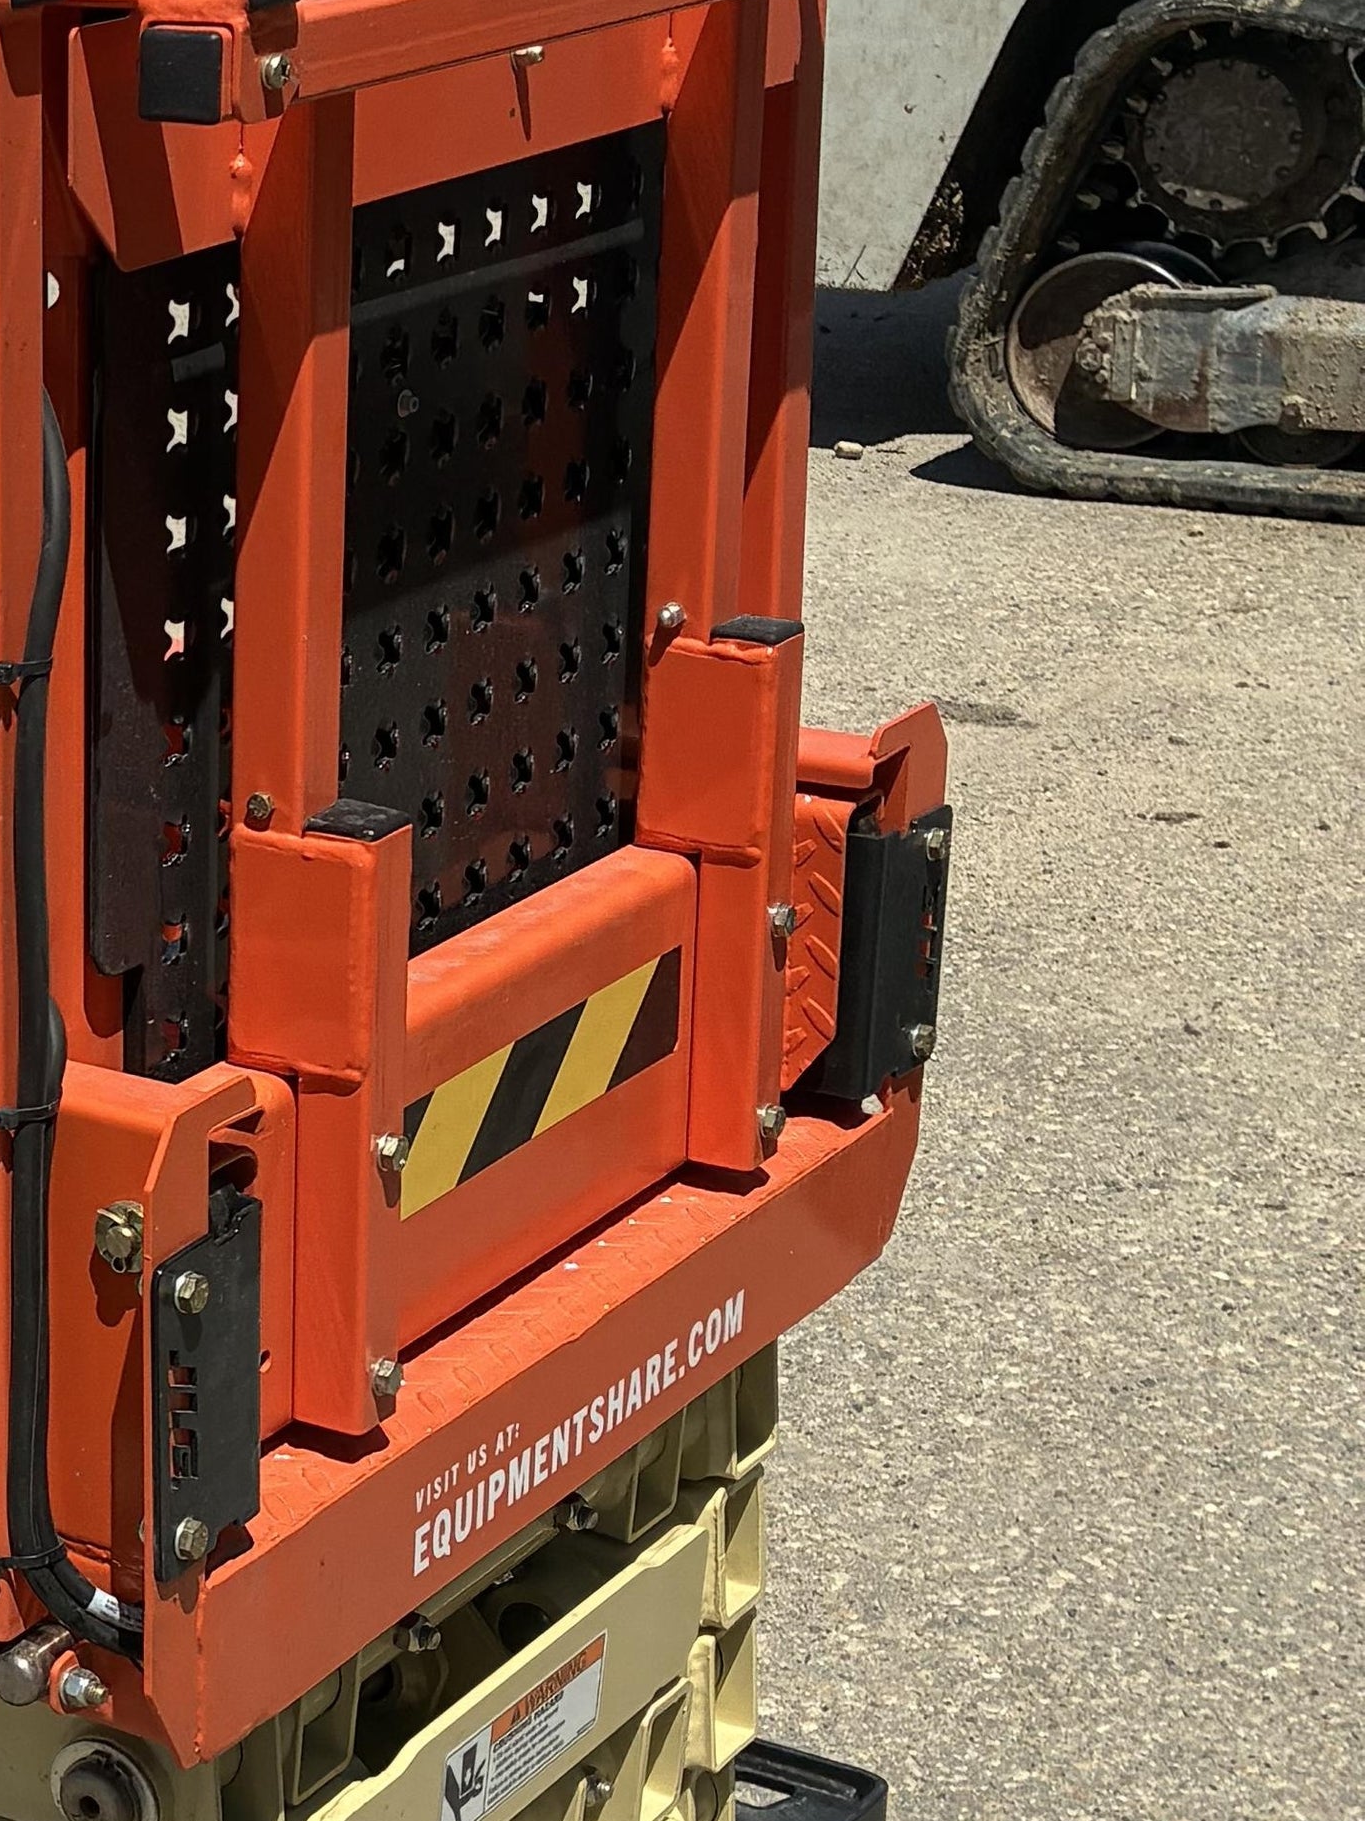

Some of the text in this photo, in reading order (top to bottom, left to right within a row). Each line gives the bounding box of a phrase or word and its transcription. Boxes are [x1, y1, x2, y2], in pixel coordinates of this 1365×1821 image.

[413, 1289, 746, 1577] EQUIPMENTSHARE.COM
[416, 1423, 520, 1513] VISIT US AT:
